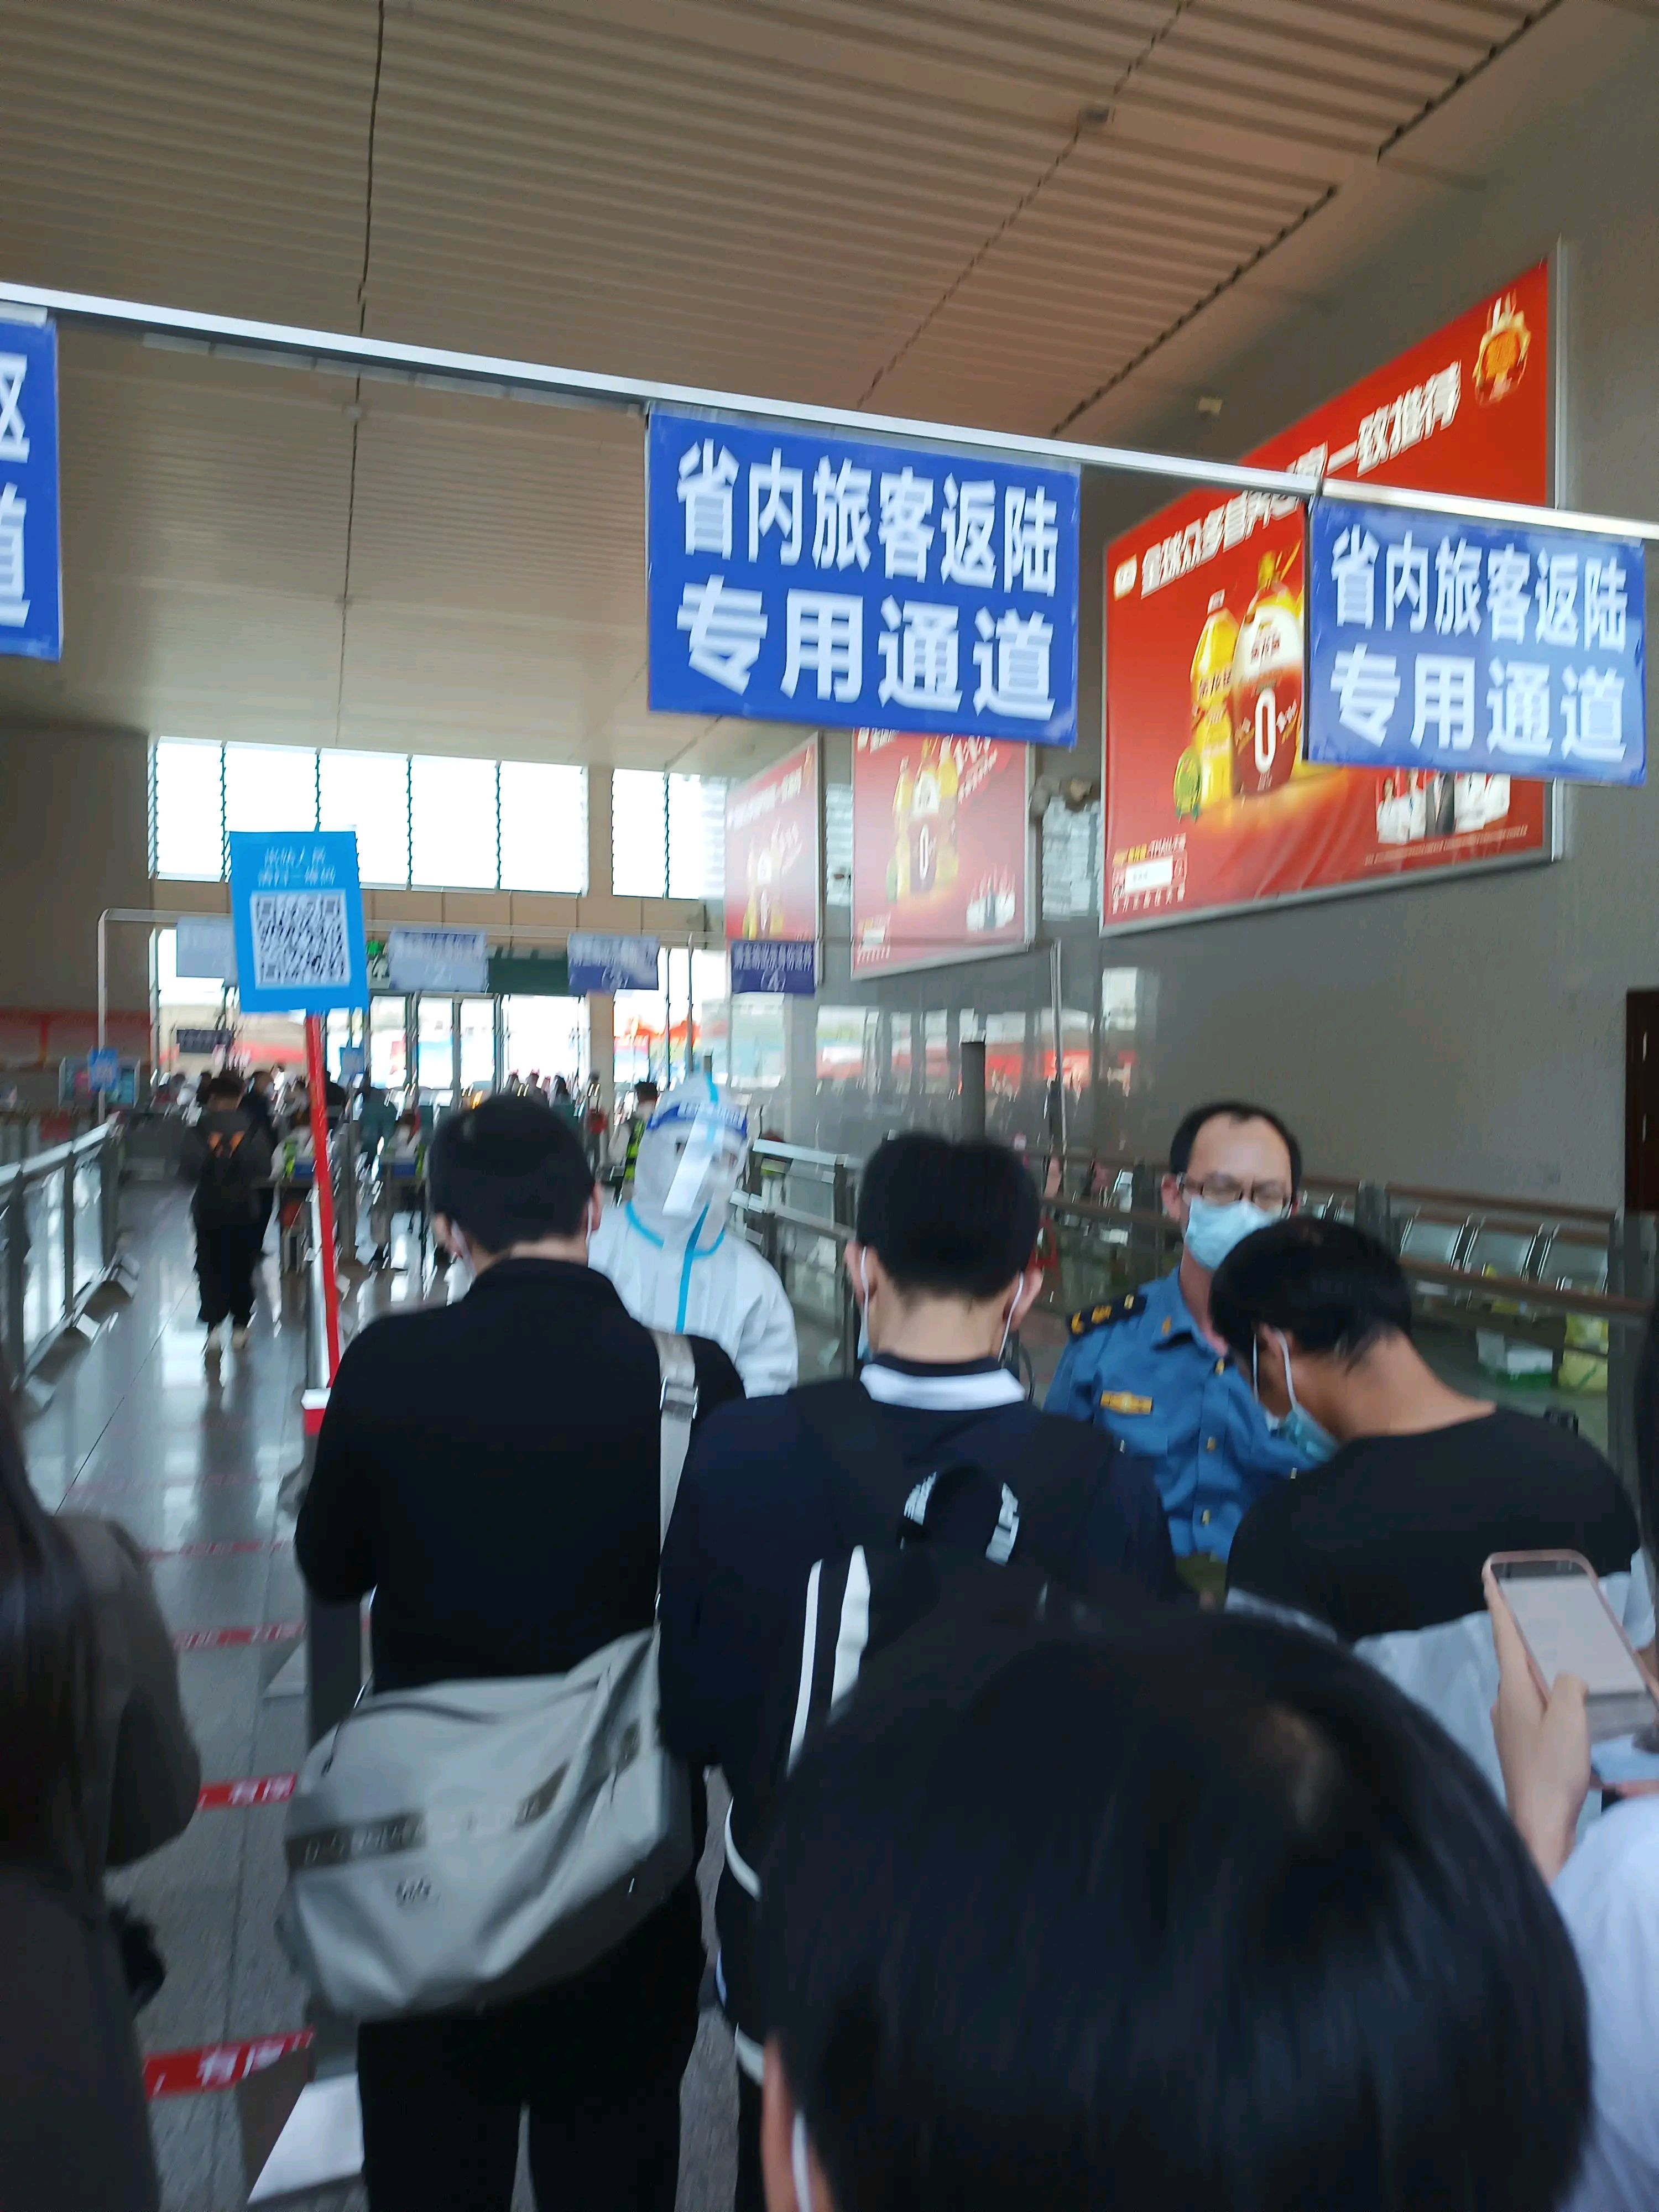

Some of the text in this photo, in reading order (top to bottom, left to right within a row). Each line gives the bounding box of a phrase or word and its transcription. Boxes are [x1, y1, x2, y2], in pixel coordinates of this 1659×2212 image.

[677, 439, 1058, 597] 省内旅客返陆
[677, 575, 1055, 722] 专用通道
[1332, 524, 1627, 653] 省内旅客返陆
[1330, 643, 1627, 763] 专用通道
